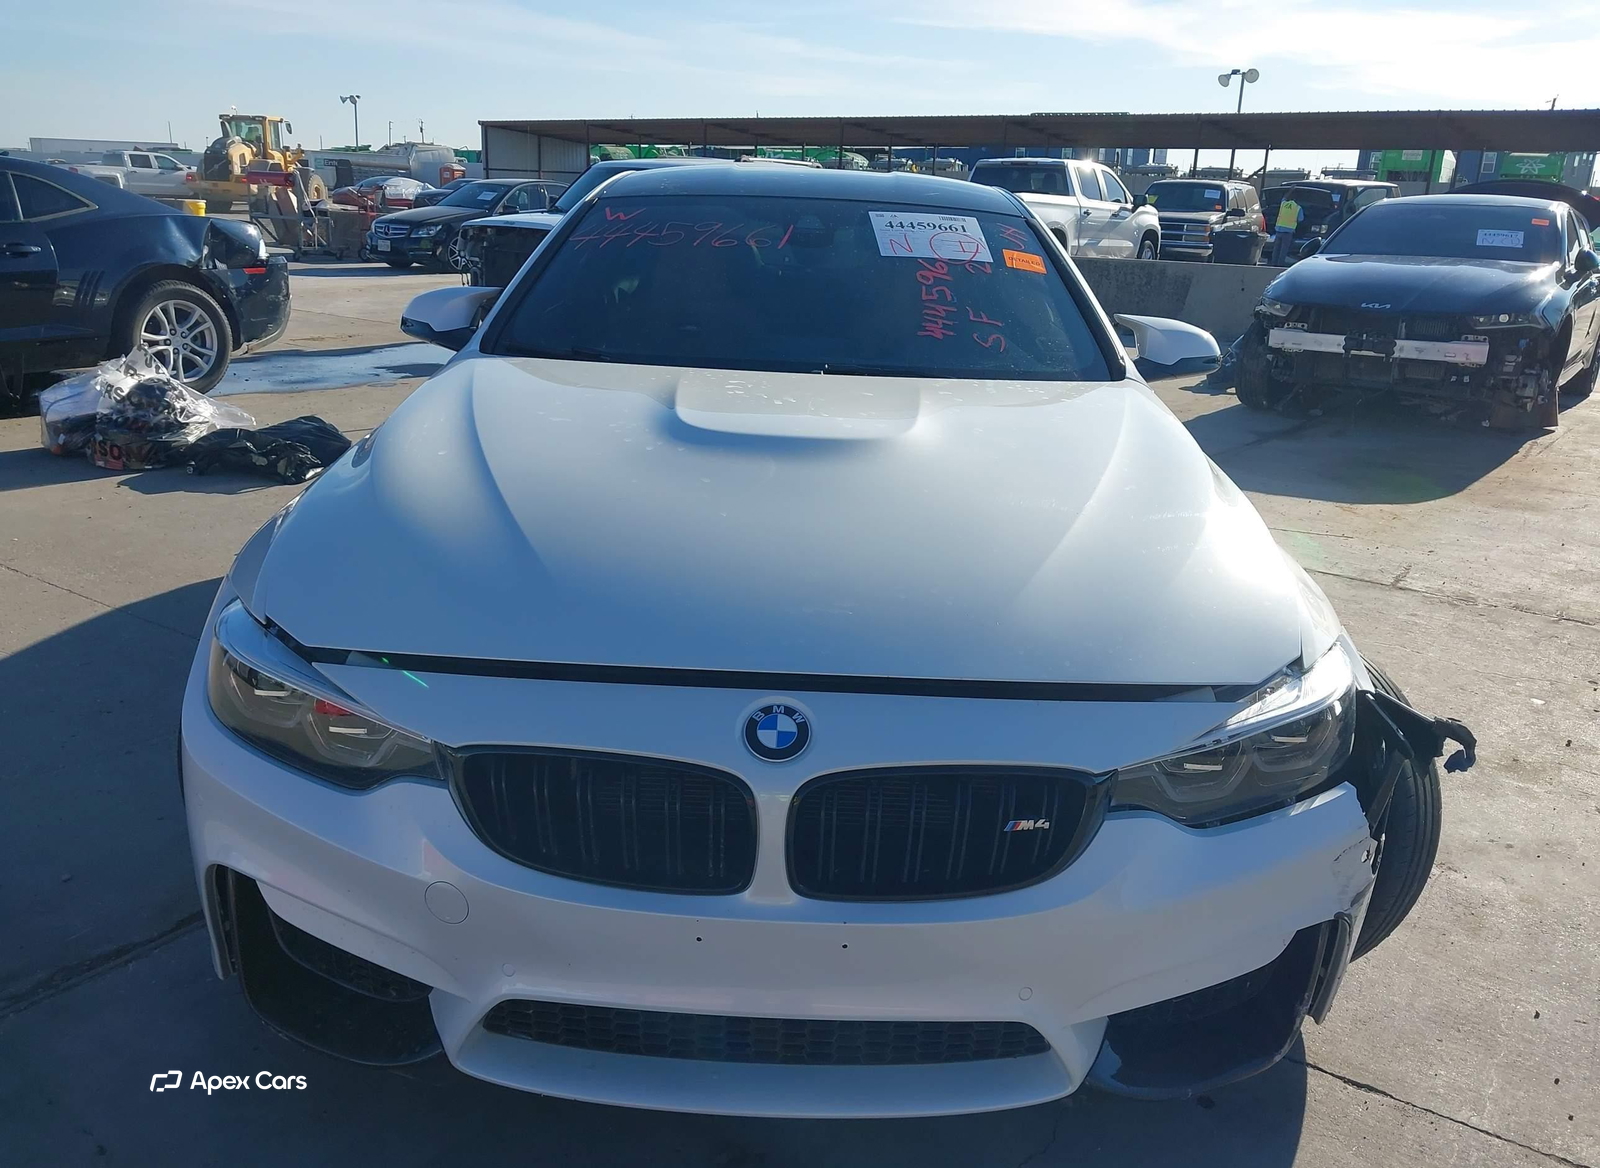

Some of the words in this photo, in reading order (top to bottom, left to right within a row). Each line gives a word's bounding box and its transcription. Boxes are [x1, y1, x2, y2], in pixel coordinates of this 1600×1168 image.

[569, 221, 793, 250] 44459661
[884, 219, 968, 233] 44459661
[889, 234, 913, 255] N
[752, 705, 805, 724] BMW
[1016, 818, 1050, 830] M4
